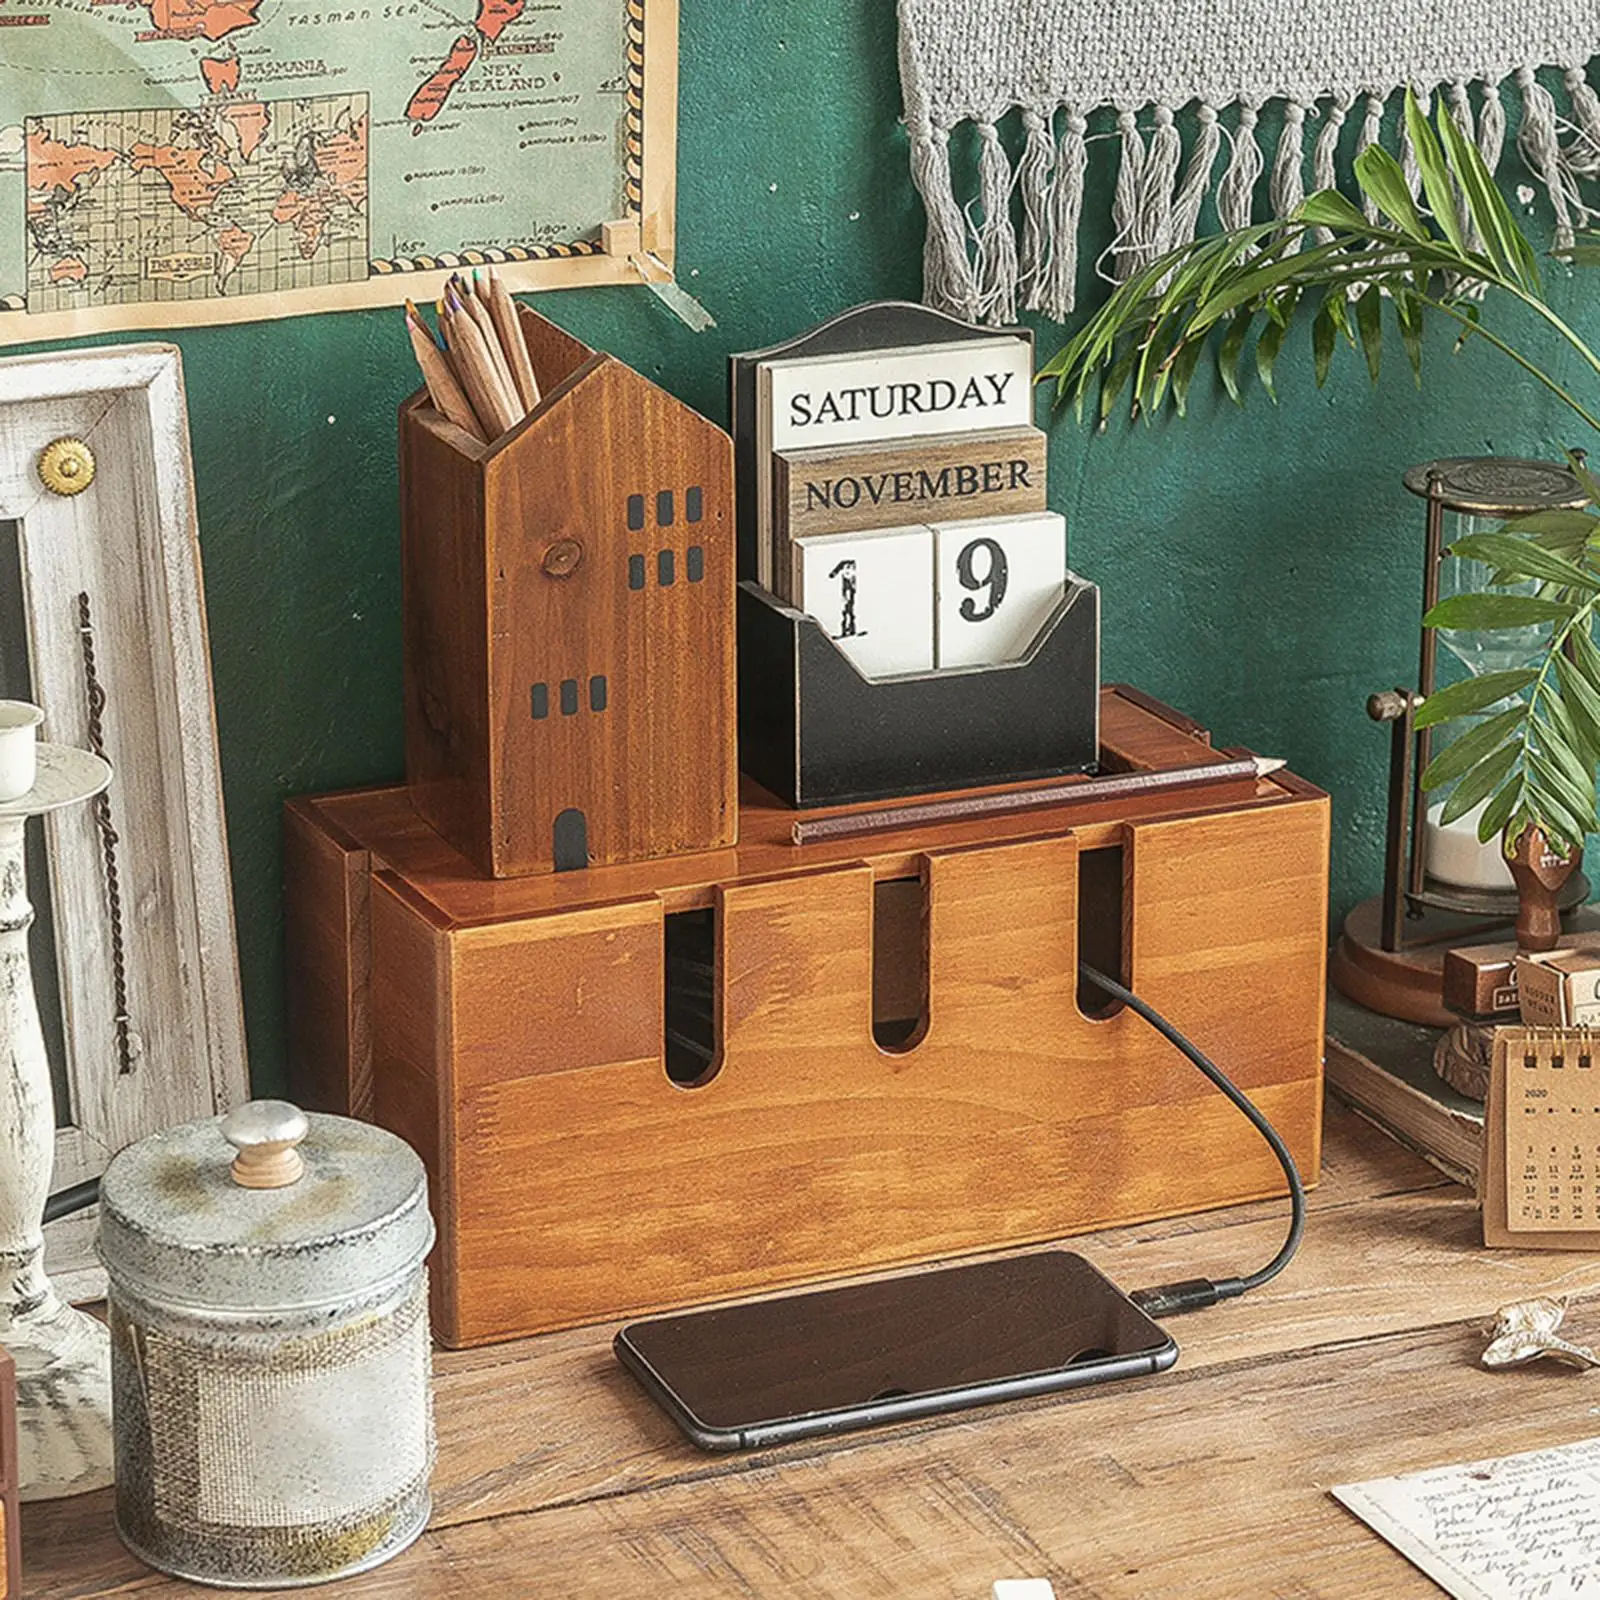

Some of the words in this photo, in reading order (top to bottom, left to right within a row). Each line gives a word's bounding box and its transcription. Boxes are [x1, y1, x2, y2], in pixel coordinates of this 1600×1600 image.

[287, 9, 371, 26] TASMAN
[244, 59, 327, 76] TASMANIA
[482, 63, 522, 77] NEW
[457, 76, 546, 93] ZEALAND
[790, 372, 1014, 427] SATURDAY
[805, 459, 1033, 512] NOVEMBER
[1524, 1088, 1549, 1099] 2020
